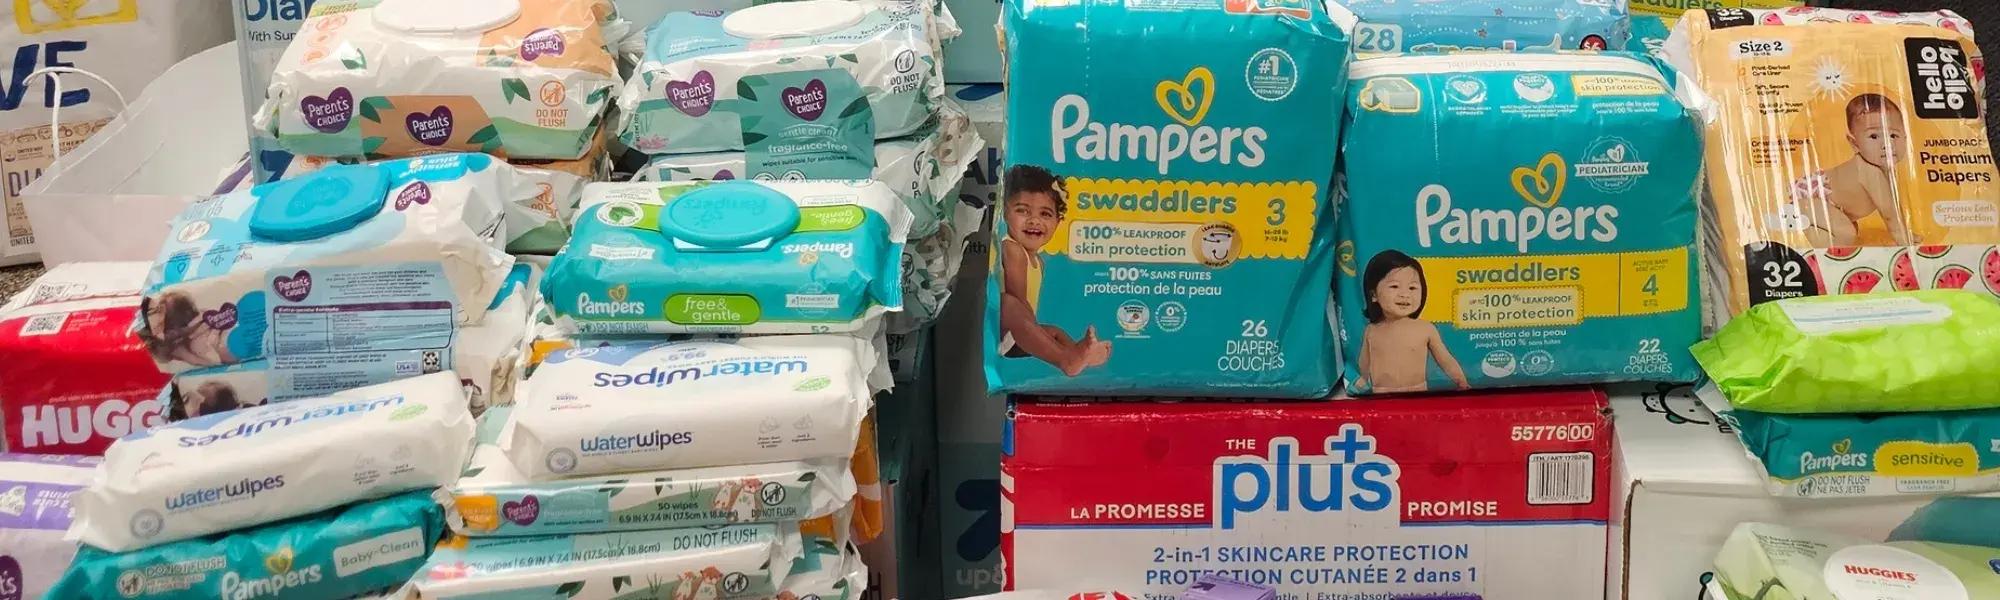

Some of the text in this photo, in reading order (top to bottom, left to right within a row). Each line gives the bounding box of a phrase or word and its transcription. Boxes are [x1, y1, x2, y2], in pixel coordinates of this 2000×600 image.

[524, 37, 561, 53] Parent's
[1359, 28, 1396, 51] 28
[1739, 41, 1783, 54] Size 2
[1258, 55, 1279, 76] #1
[890, 73, 920, 86] DO NOT
[1917, 46, 1946, 109] hello
[1938, 47, 1968, 110] bello
[672, 81, 712, 100] Parent's
[893, 82, 919, 94] FLUSH
[1605, 84, 1661, 93] protection
[682, 96, 709, 109] CHOICE
[788, 88, 824, 106] Parent's
[308, 96, 350, 119] Parent's
[536, 109, 568, 118] DO NOT
[797, 102, 822, 113] CHOICE
[317, 112, 347, 126] CHOICE
[412, 113, 450, 132] Parent's
[538, 119, 566, 127] FLUSH
[421, 128, 448, 140] CHOICE
[1051, 94, 1268, 175] Pampers
[768, 141, 848, 154] fragrance-free
[1924, 138, 1957, 147] JUMBO
[762, 159, 781, 168] wipes
[782, 157, 806, 165] suitable
[807, 156, 816, 164] for
[1920, 151, 1992, 165] Premium
[1579, 165, 1645, 175] PEDIATRICIAN
[1928, 169, 1991, 186] Diapers
[1077, 189, 1238, 214] swaddlers
[1936, 203, 1995, 214] Serious Leak
[1266, 198, 1287, 226] 3
[1416, 184, 1619, 254] Pampers
[1943, 213, 1993, 223] Protection
[1084, 226, 1187, 240] 100% LEAKPROOF
[783, 241, 854, 258] Pampers
[1075, 243, 1186, 258] skin protection
[1109, 267, 1212, 281] 100% SANS FUITES
[1456, 262, 1581, 284] swaddlers
[1763, 261, 1803, 287] 32
[278, 276, 310, 291] Parent's
[1084, 283, 1222, 298] protection de la peau
[1641, 274, 1659, 296] 4
[1484, 294, 1573, 307] 100% LEAKPROOF
[1765, 289, 1804, 299] Diapers
[578, 293, 645, 317] Pampers
[684, 297, 728, 312] free&
[692, 309, 741, 322] gentle
[1462, 307, 1574, 323] skin protection
[1241, 320, 1268, 337] 26
[1470, 329, 1567, 341] protection de la peau
[1226, 340, 1279, 355] DIAPERS
[1501, 338, 1527, 347] 100 %
[1639, 339, 1660, 353] 22
[1218, 353, 1285, 372] COUCHES
[1630, 352, 1668, 365] DIAPERS
[1623, 363, 1673, 374] COUCHES
[1511, 424, 1594, 442] 5577600
[1226, 439, 1256, 450] THE
[1801, 451, 1868, 474] Pampers
[1892, 452, 1964, 468] sensitive
[1221, 430, 1393, 529] plus
[1817, 476, 1870, 485] DO NOT FLUSH
[1817, 485, 1866, 494] NE PAS JETER
[672, 502, 699, 511] wipes
[751, 508, 797, 518] DO NOT FLUSH
[1071, 504, 1205, 518] LA PROMESSE
[1408, 501, 1498, 516] PROMISE
[619, 515, 631, 524] 6.9
[633, 515, 642, 523] IN
[643, 514, 649, 522] X
[663, 513, 671, 522] IN
[673, 529, 758, 551] DO NOT FLUSH
[341, 538, 419, 568] Baby-Clean
[535, 556, 546, 565] IN
[571, 552, 581, 562] IN
[627, 542, 661, 556] 18.8cm)
[1154, 544, 1469, 563] 2-in-1 SKINCARE PROTECTION
[1290, 565, 1388, 584] CUTANÉE
[1395, 568, 1407, 583] 2
[1414, 567, 1462, 583] dans
[1468, 567, 1476, 582] 1
[1844, 564, 1917, 582] HUGGIES
[221, 564, 323, 600] Pampers
